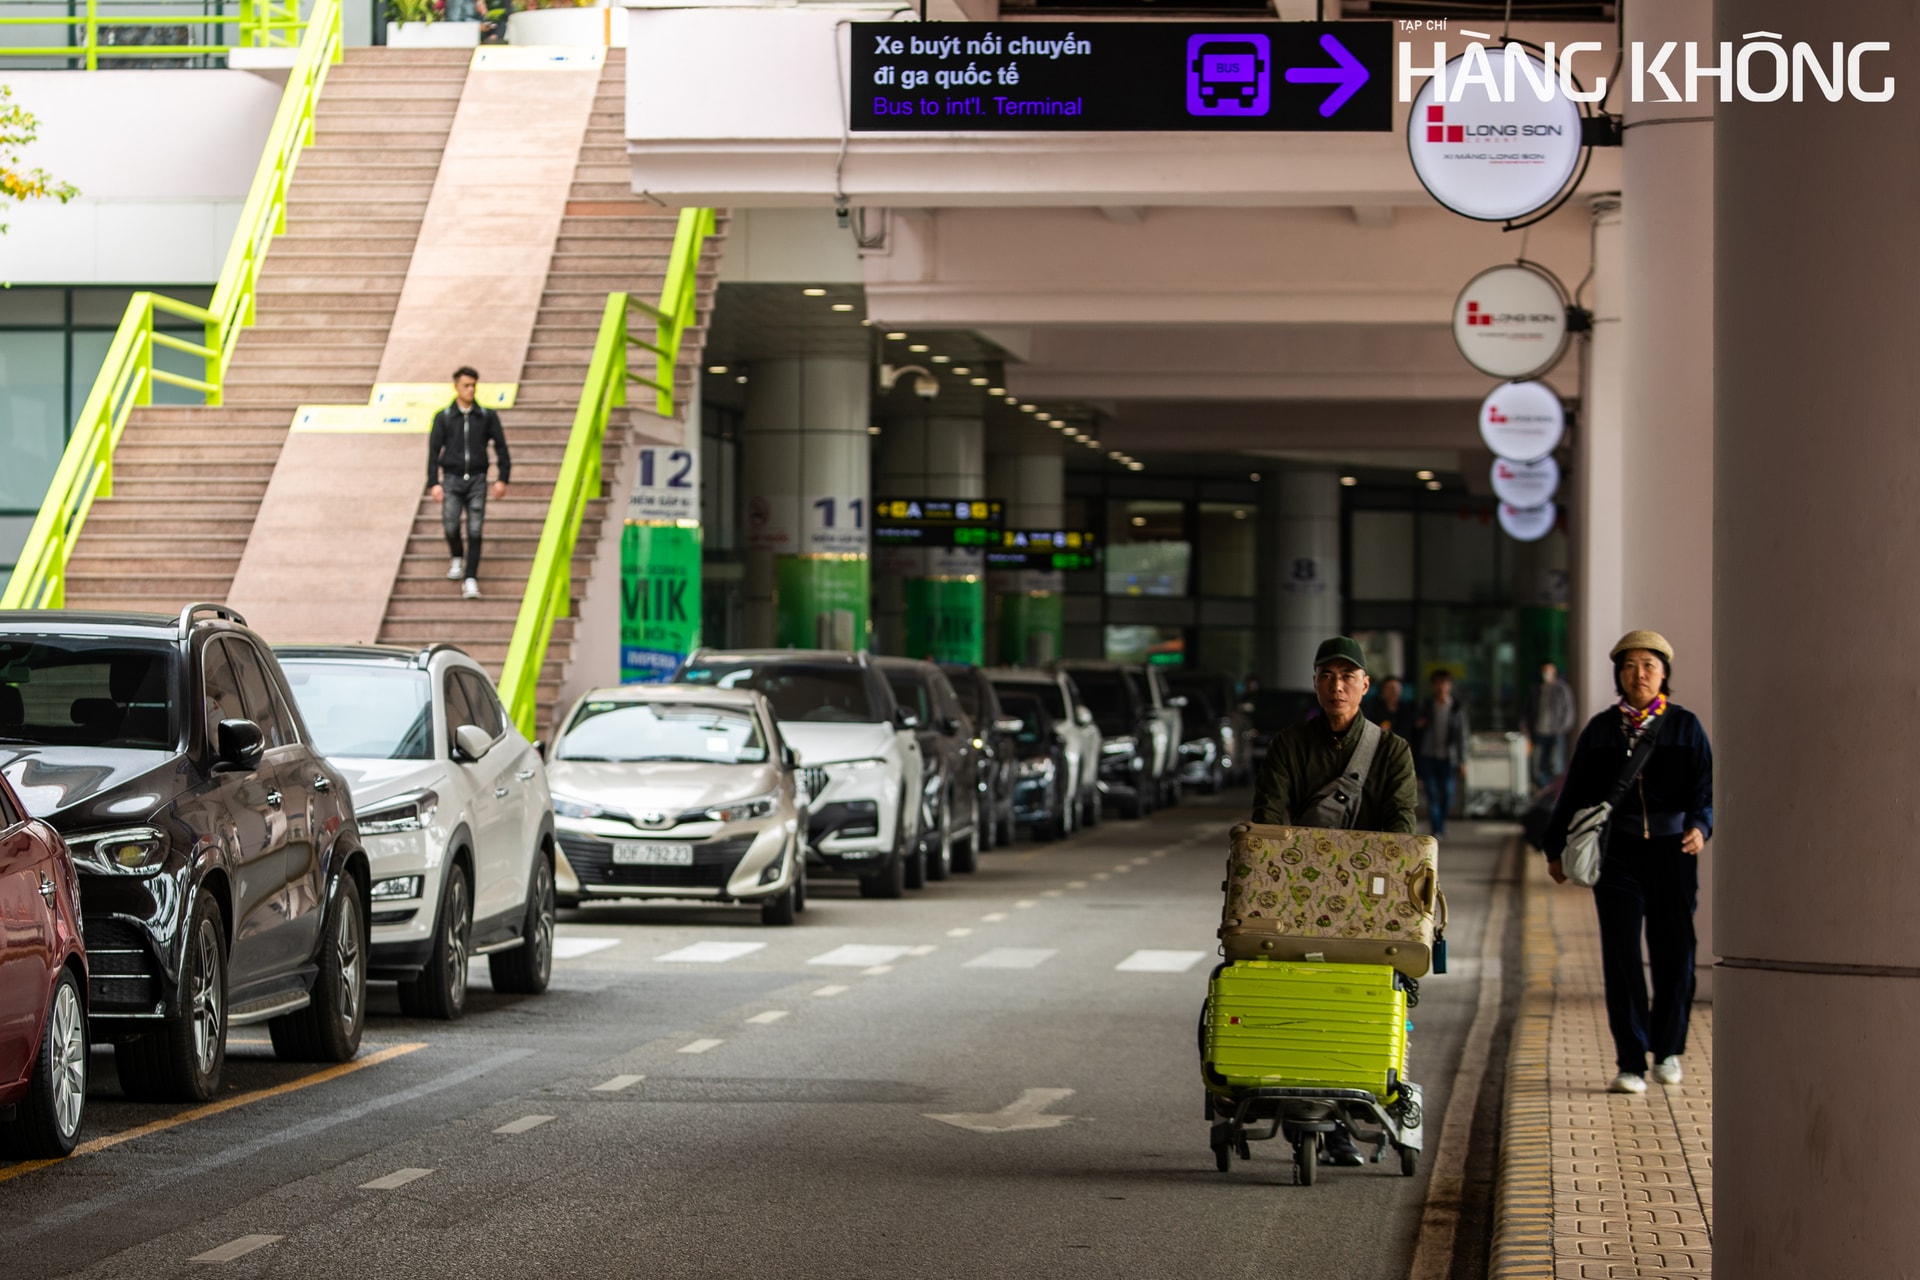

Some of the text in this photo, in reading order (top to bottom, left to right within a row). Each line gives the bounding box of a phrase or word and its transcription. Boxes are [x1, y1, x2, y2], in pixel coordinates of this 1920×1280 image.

[874, 32, 1091, 60] Xe buýt nối chuyến
[873, 62, 1020, 90] đi ga quốc tế
[1217, 63, 1240, 73] BUS
[873, 97, 913, 116] Bus
[920, 98, 939, 116] to
[994, 97, 1083, 116] Terminal
[1465, 125, 1562, 137] LONG SON
[639, 449, 692, 488] 12
[814, 497, 862, 528] 11
